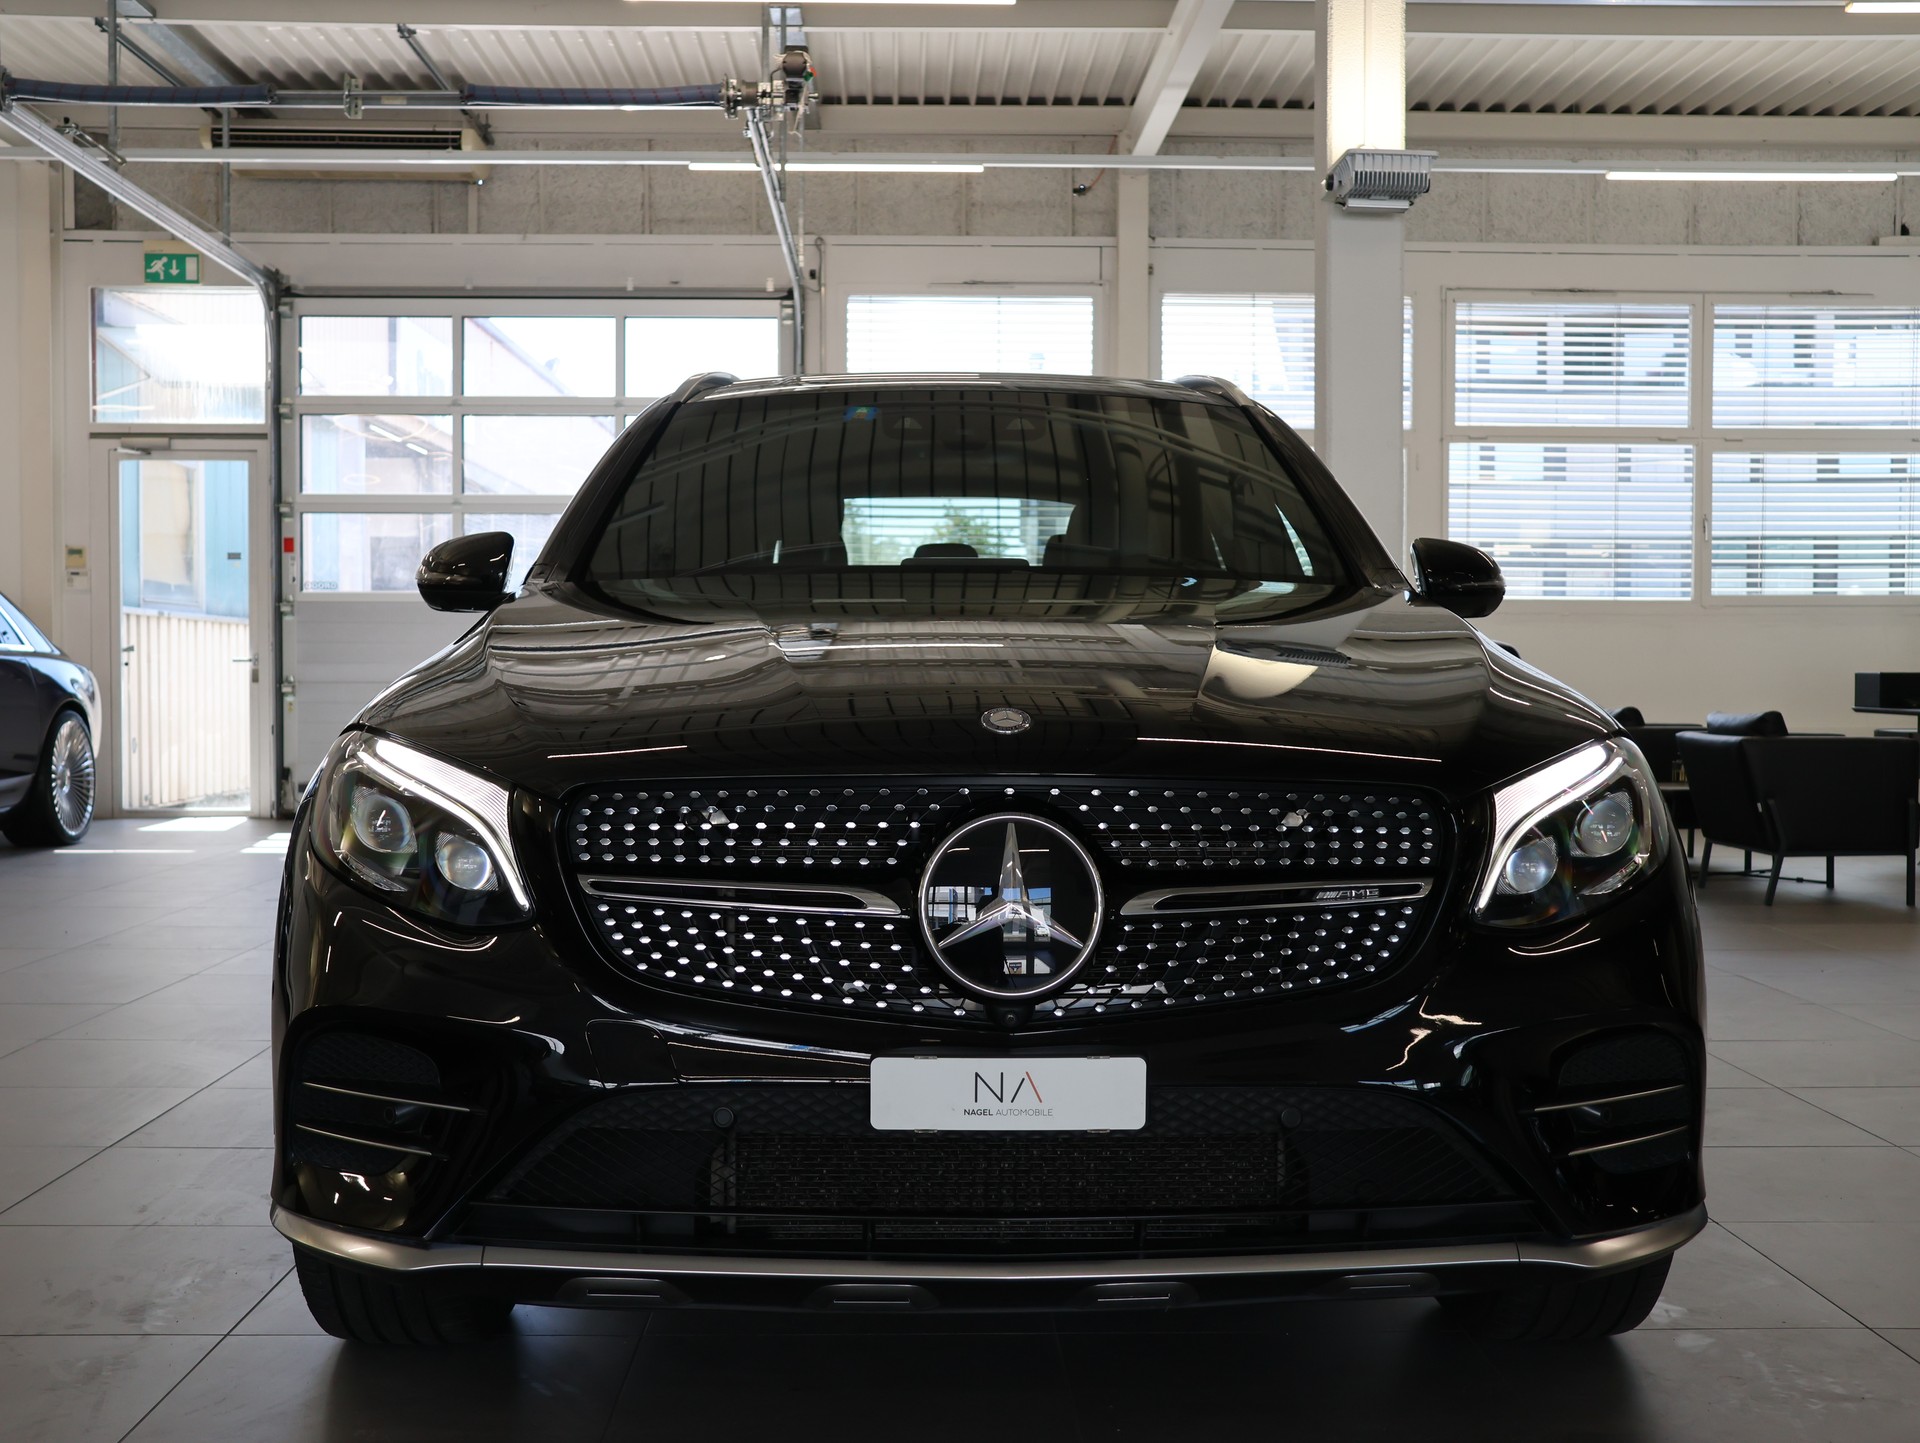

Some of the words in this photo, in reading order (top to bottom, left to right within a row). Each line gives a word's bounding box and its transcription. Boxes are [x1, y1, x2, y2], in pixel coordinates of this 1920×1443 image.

[1336, 888, 1379, 899] AMG
[963, 1108, 994, 1117] NAGEL
[995, 1108, 1054, 1117] AUTOMOBILE
